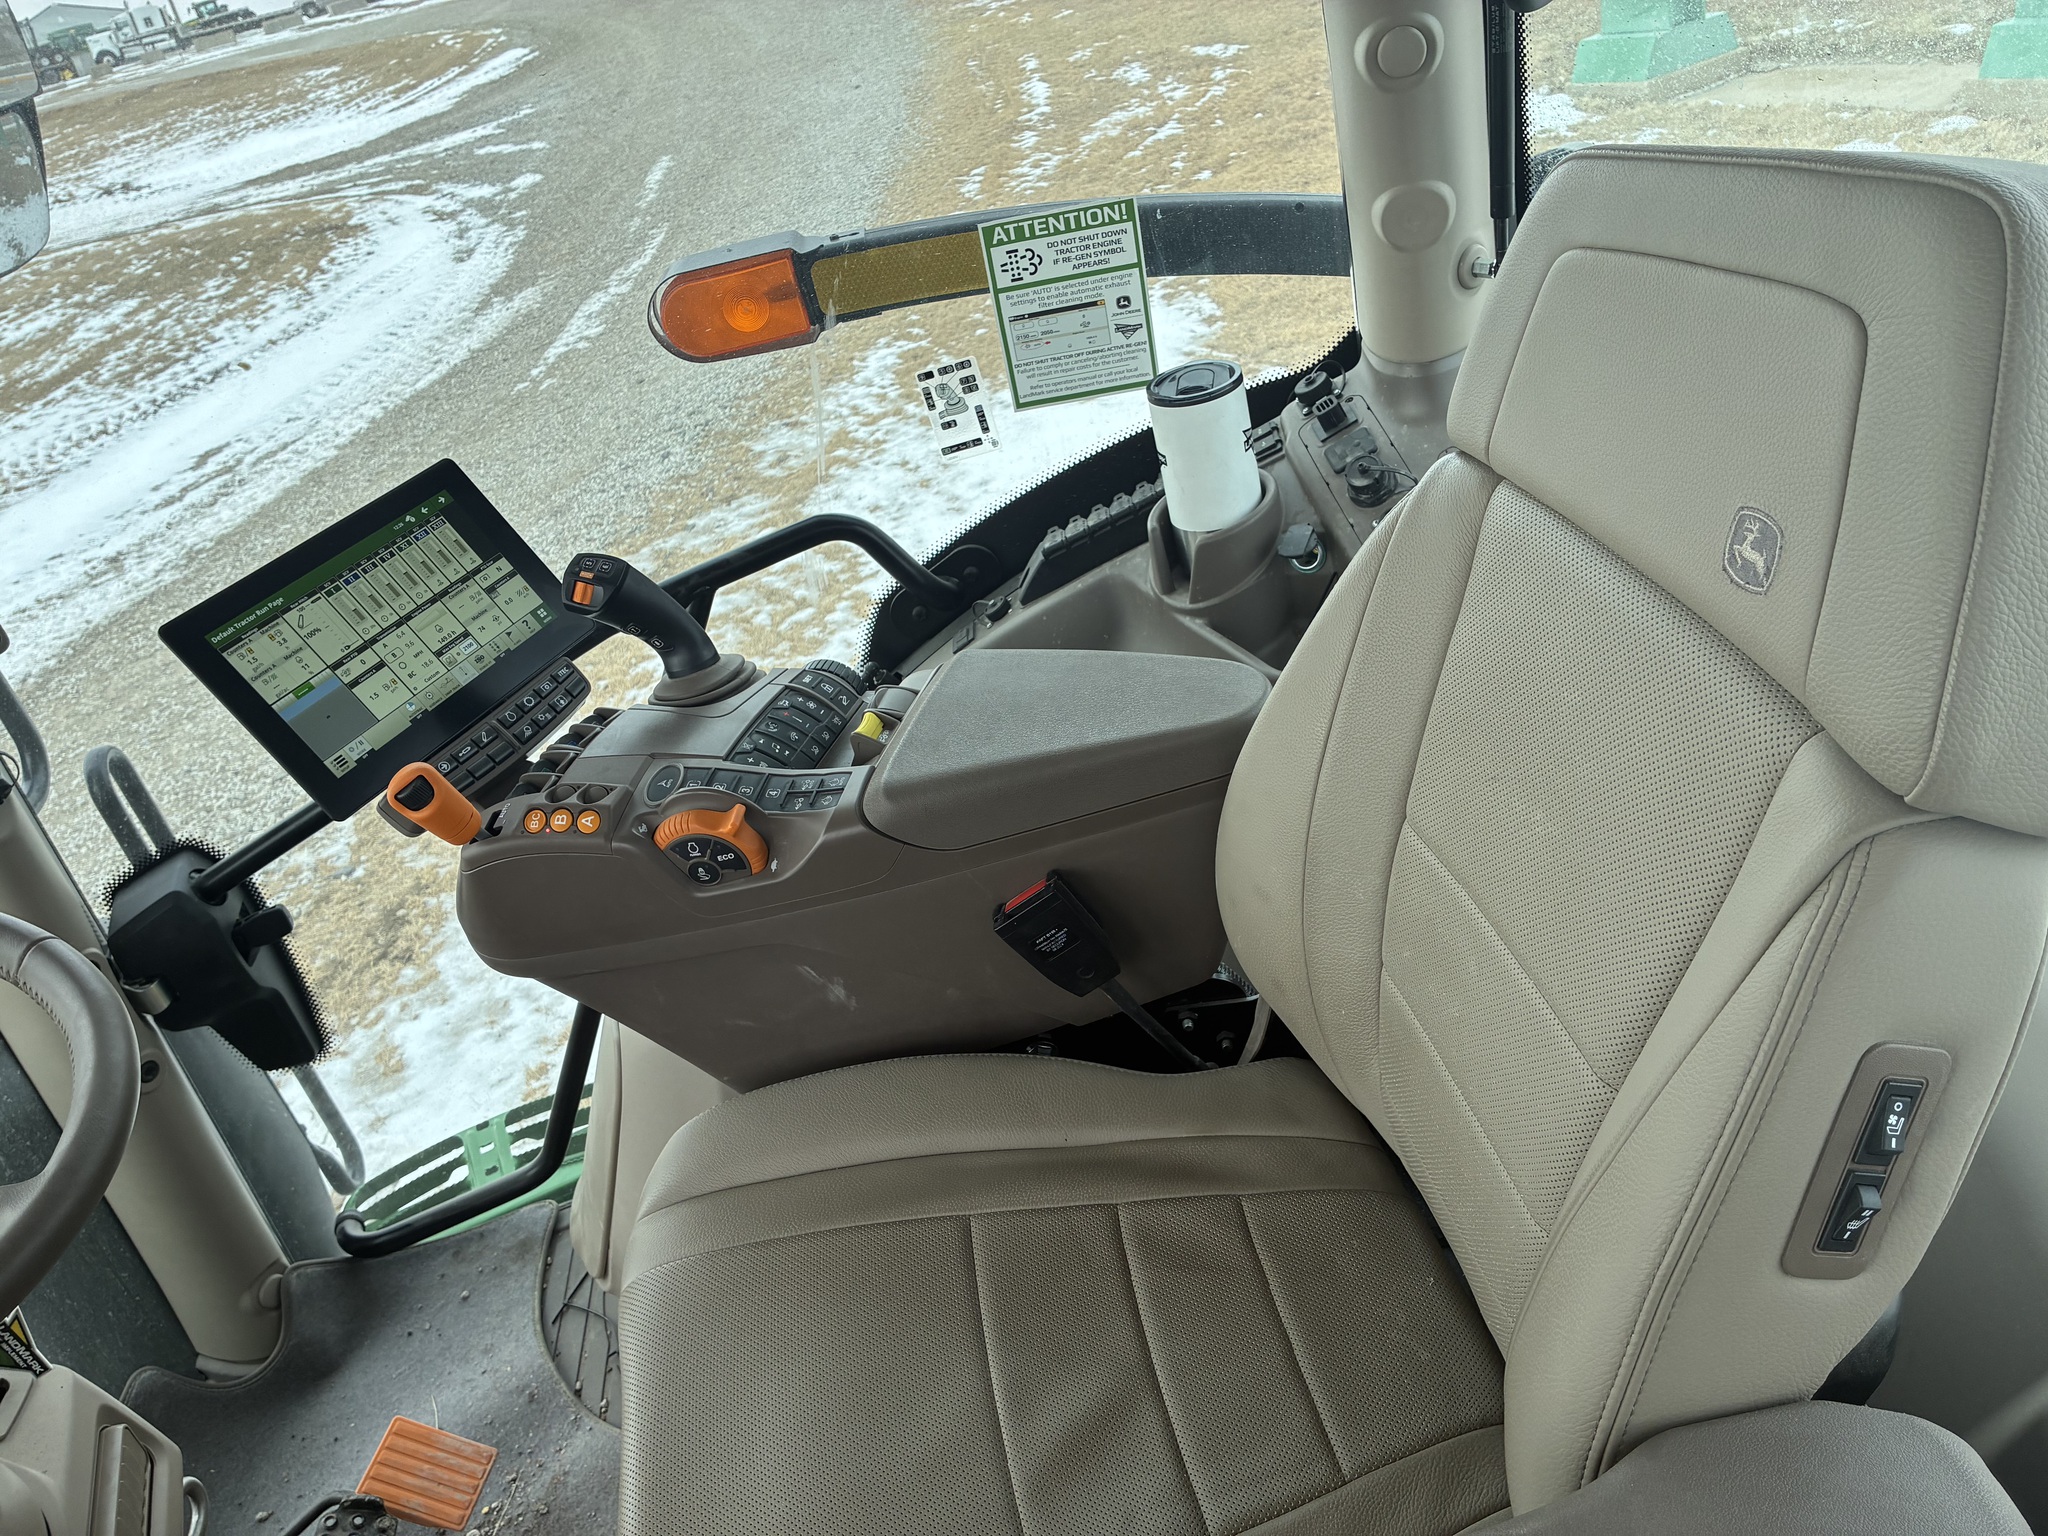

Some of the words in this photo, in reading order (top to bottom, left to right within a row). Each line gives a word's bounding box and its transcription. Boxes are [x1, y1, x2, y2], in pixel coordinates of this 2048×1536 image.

[992, 203, 1127, 244] ATTENTION!
[1046, 240, 1059, 248] DO
[1060, 237, 1076, 246] NOT
[1078, 233, 1099, 243] SHUT
[1101, 228, 1127, 238] DOWN
[1054, 243, 1091, 255] TRACTOR
[1092, 237, 1122, 249] ENGINE
[1061, 252, 1092, 263] RE-GEN
[1093, 246, 1126, 257] SYMBOL
[1072, 258, 1110, 270] APPEARS!
[1061, 280, 1089, 290] selected
[1090, 276, 1109, 284] under
[1110, 272, 1133, 281] engine
[1009, 298, 1036, 307] settings
[1046, 291, 1068, 300] enable
[1070, 285, 1103, 295] automatic
[1104, 279, 1130, 289] exhaust
[1055, 296, 1083, 305] cleaning
[1083, 292, 1104, 300] mode.
[1043, 362, 1063, 370] comply
[1123, 347, 1146, 355] cleaning
[1049, 354, 1073, 362] TRACTOR
[1051, 378, 1077, 387] operators
[1064, 381, 1095, 391] department
[431, 519, 444, 529] XIII
[416, 530, 427, 539] XII
[382, 552, 390, 560] IV
[365, 564, 374, 572] III
[448, 586, 466, 600] Counters
[504, 597, 513, 605] 0.0
[211, 627, 235, 643] Default
[233, 613, 256, 628] Tractor
[255, 606, 269, 616] Run
[267, 597, 284, 608] Page
[471, 608, 488, 621] Machine
[259, 621, 279, 635] Machine
[303, 627, 321, 640] 100%
[395, 630, 405, 639] 6.4
[437, 632, 452, 644] 149.0
[276, 637, 288, 646] 3.8
[462, 641, 474, 651] 2100
[226, 641, 248, 656] Counters
[283, 647, 303, 660] Machine
[413, 650, 423, 658] MPH
[247, 656, 258, 665] 1.5
[474, 654, 485, 663] ISO
[250, 667, 272, 681] Counters
[407, 670, 416, 679] BC
[424, 670, 440, 683] Custom
[369, 692, 379, 700] 1.5
[530, 813, 541, 828] BC
[555, 814, 567, 825] B
[581, 816, 595, 827] A
[717, 853, 735, 861] ECO
